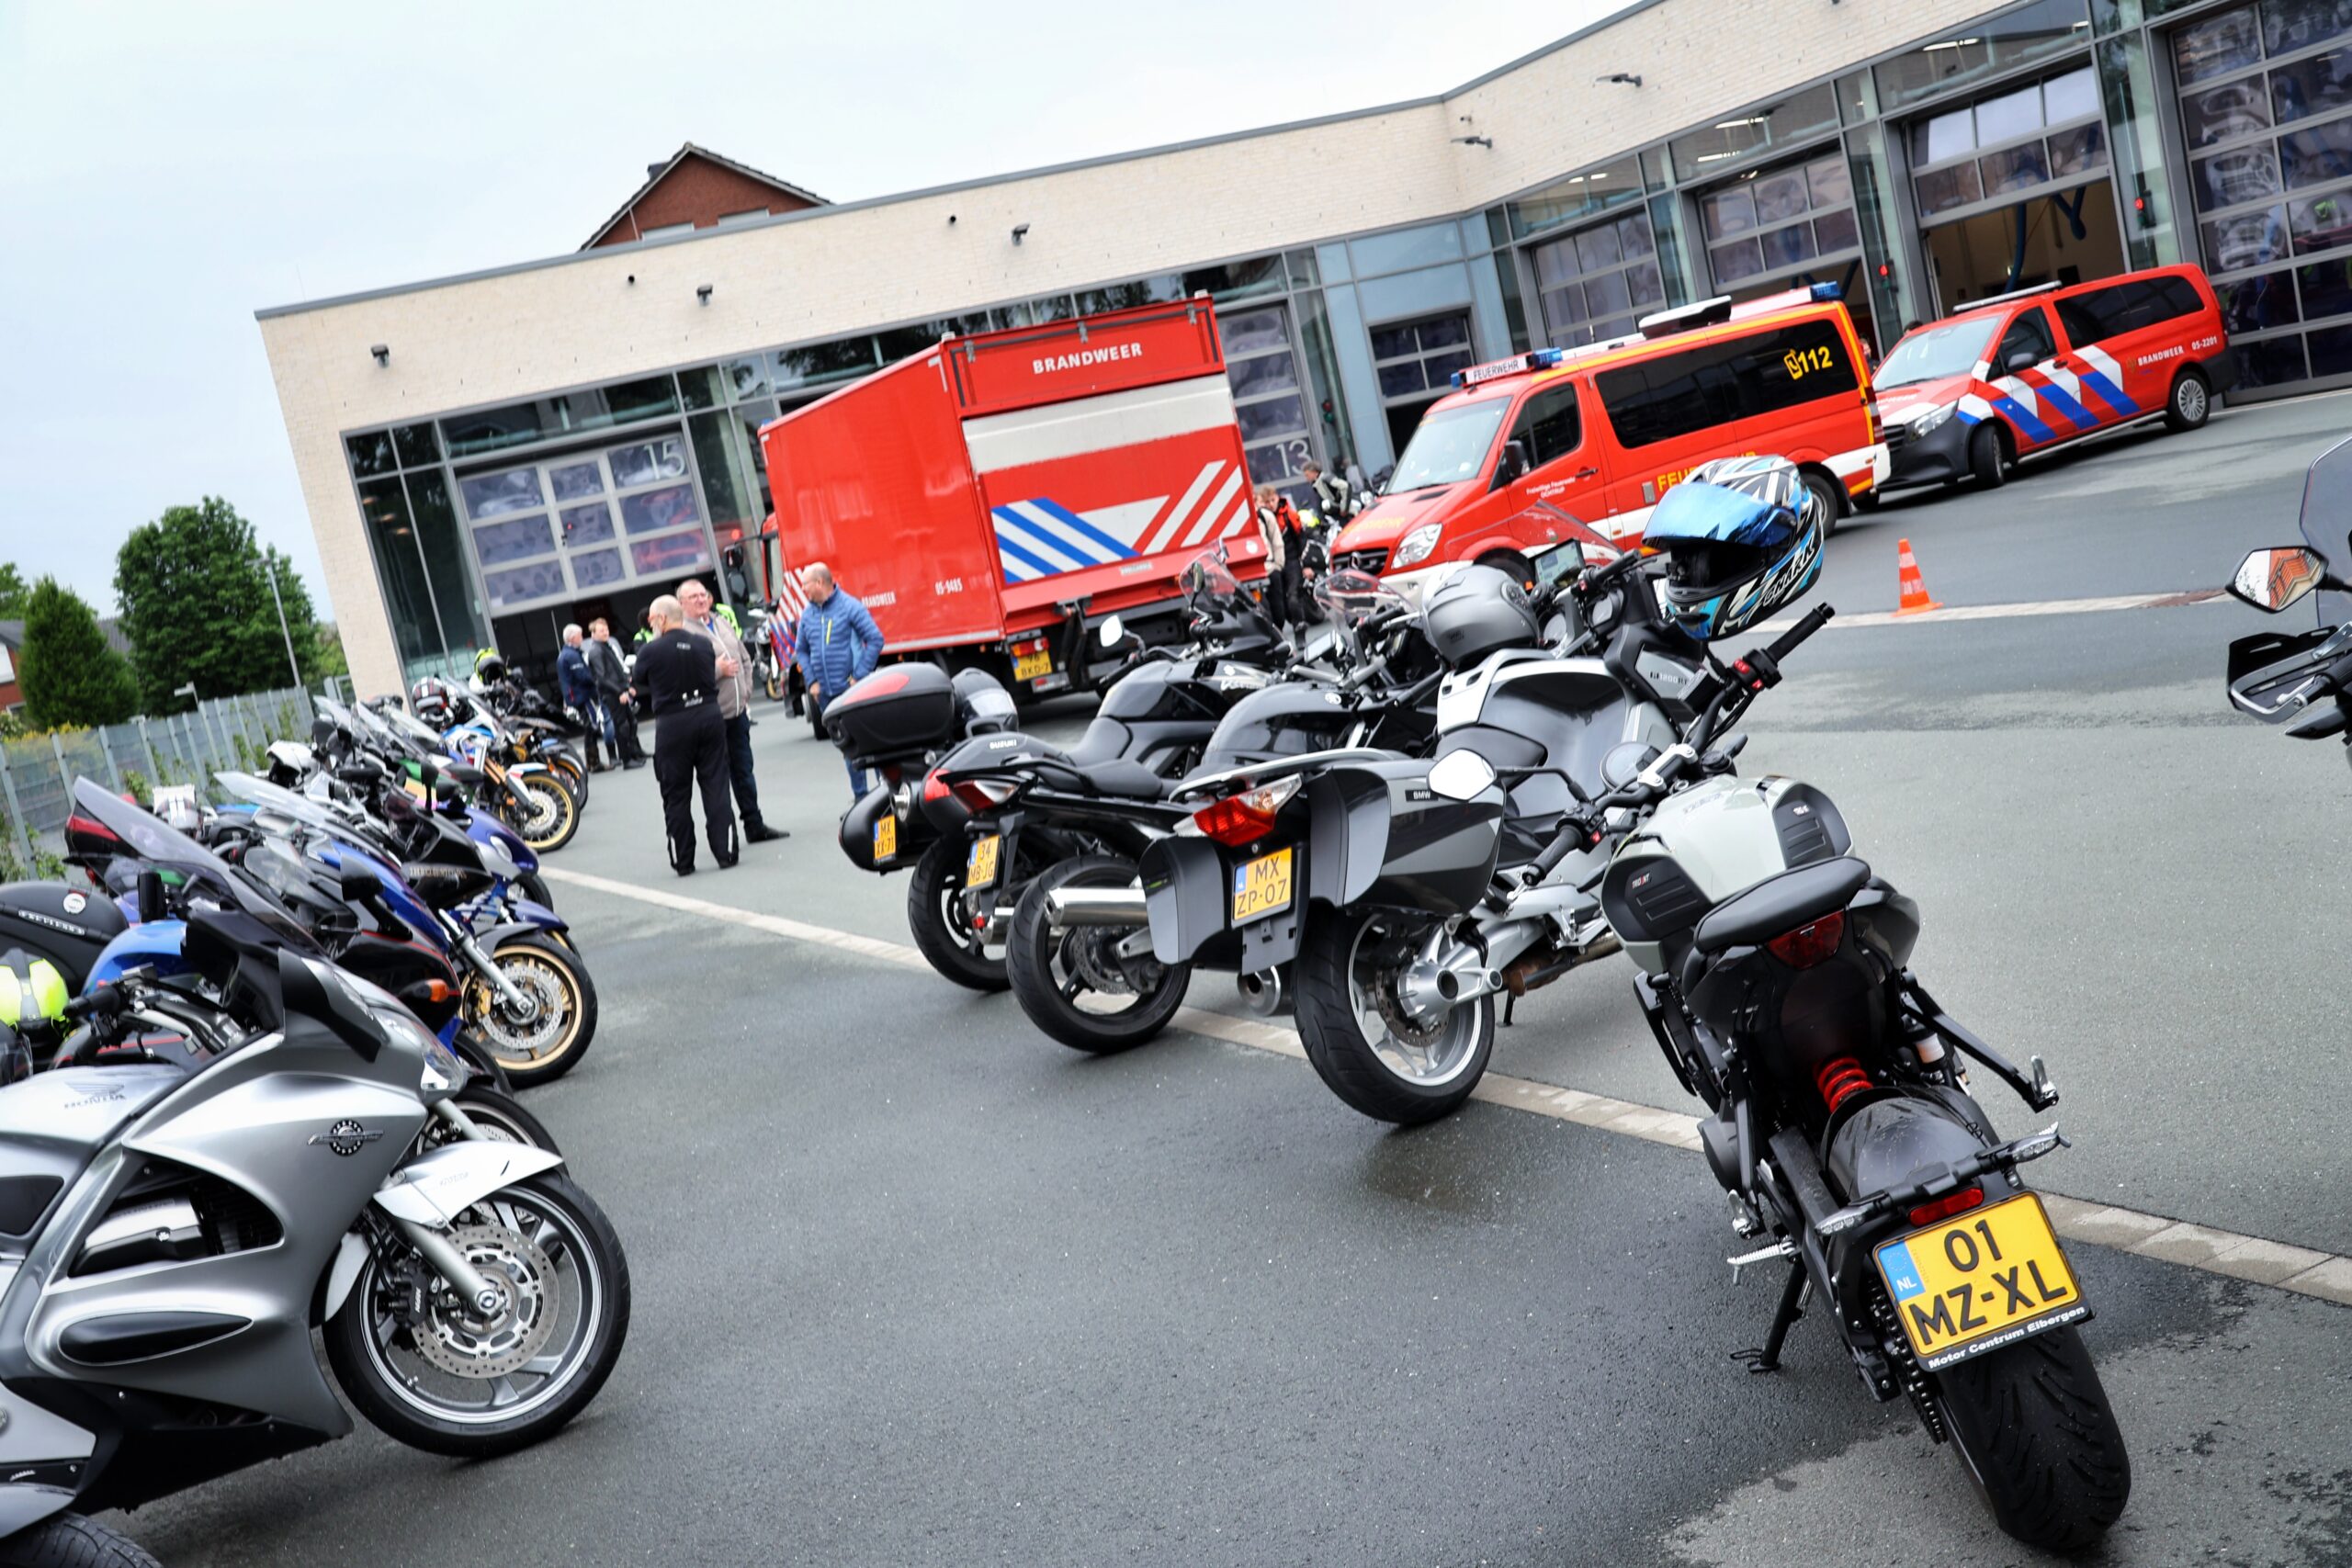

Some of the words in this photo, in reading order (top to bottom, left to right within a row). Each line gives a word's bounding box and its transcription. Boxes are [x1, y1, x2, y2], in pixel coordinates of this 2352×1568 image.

[1033, 342, 1142, 375] BRANDWEER
[1798, 345, 1833, 373] 112
[2138, 345, 2184, 367] BRANDWEER
[2191, 336, 2218, 350] 05-2201
[1473, 359, 1520, 380] FEUERWEHR
[643, 438, 685, 479] 15
[1275, 439, 1313, 478] 13
[1413, 790, 1430, 800] BMW
[880, 820, 891, 834] MX
[980, 841, 991, 860] 34
[1255, 855, 1279, 884] MX
[1237, 878, 1287, 916] ZP-07
[1943, 1218, 2003, 1272] 01
[1896, 1276, 1917, 1292] NL
[1908, 1259, 2068, 1346] MZ-XL
[1928, 1348, 1966, 1369] Motor
[1968, 1328, 2025, 1354] Centrum
[2027, 1306, 2086, 1334] Eibergen
